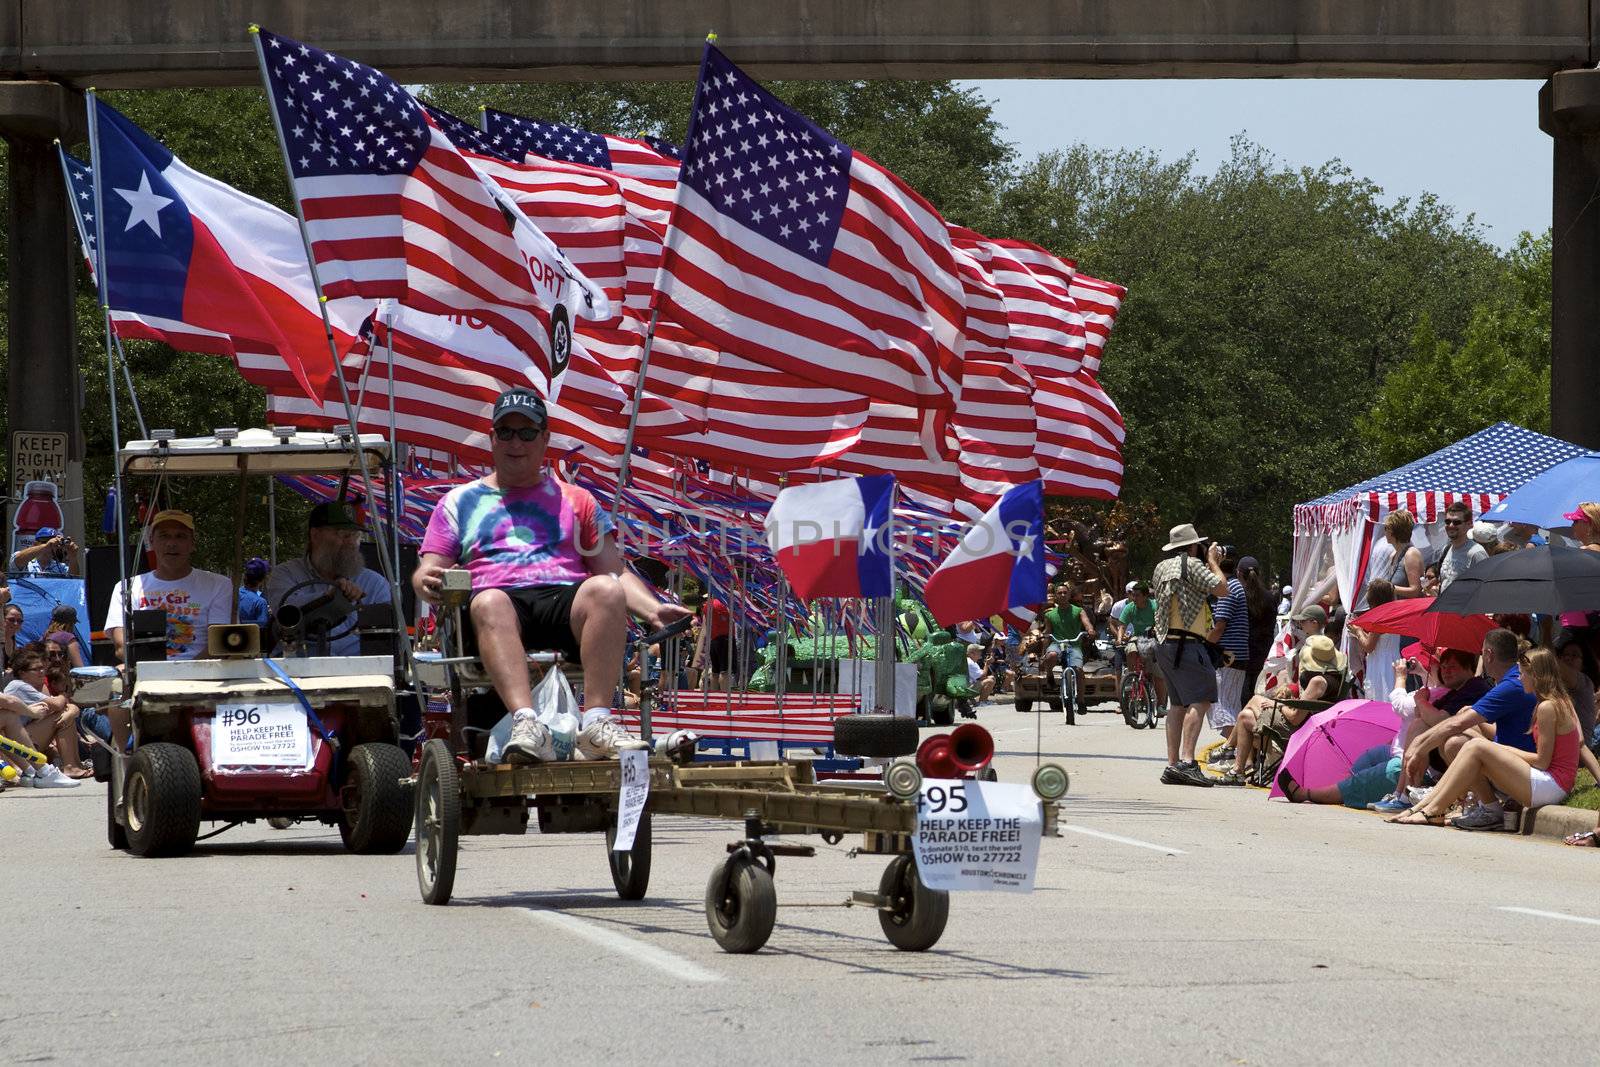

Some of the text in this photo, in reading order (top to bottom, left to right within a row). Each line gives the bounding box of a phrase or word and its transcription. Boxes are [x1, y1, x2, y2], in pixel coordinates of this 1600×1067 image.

[20, 437, 62, 451] KEEP
[17, 453, 64, 467] RIGHT
[16, 469, 64, 483] 2-WAY
[166, 592, 191, 604] Car
[222, 707, 261, 727] #96
[230, 727, 252, 736] HELP
[253, 725, 275, 734] KEEP
[230, 731, 294, 741] PARADE FREE!
[920, 817, 1021, 831] HELP KEEP THE
[919, 830, 1020, 843] PARADE FREE!
[927, 845, 953, 853] donate
[988, 844, 1001, 852] the
[1003, 844, 1022, 852] word
[921, 852, 1021, 865] OSHOW to 27722
